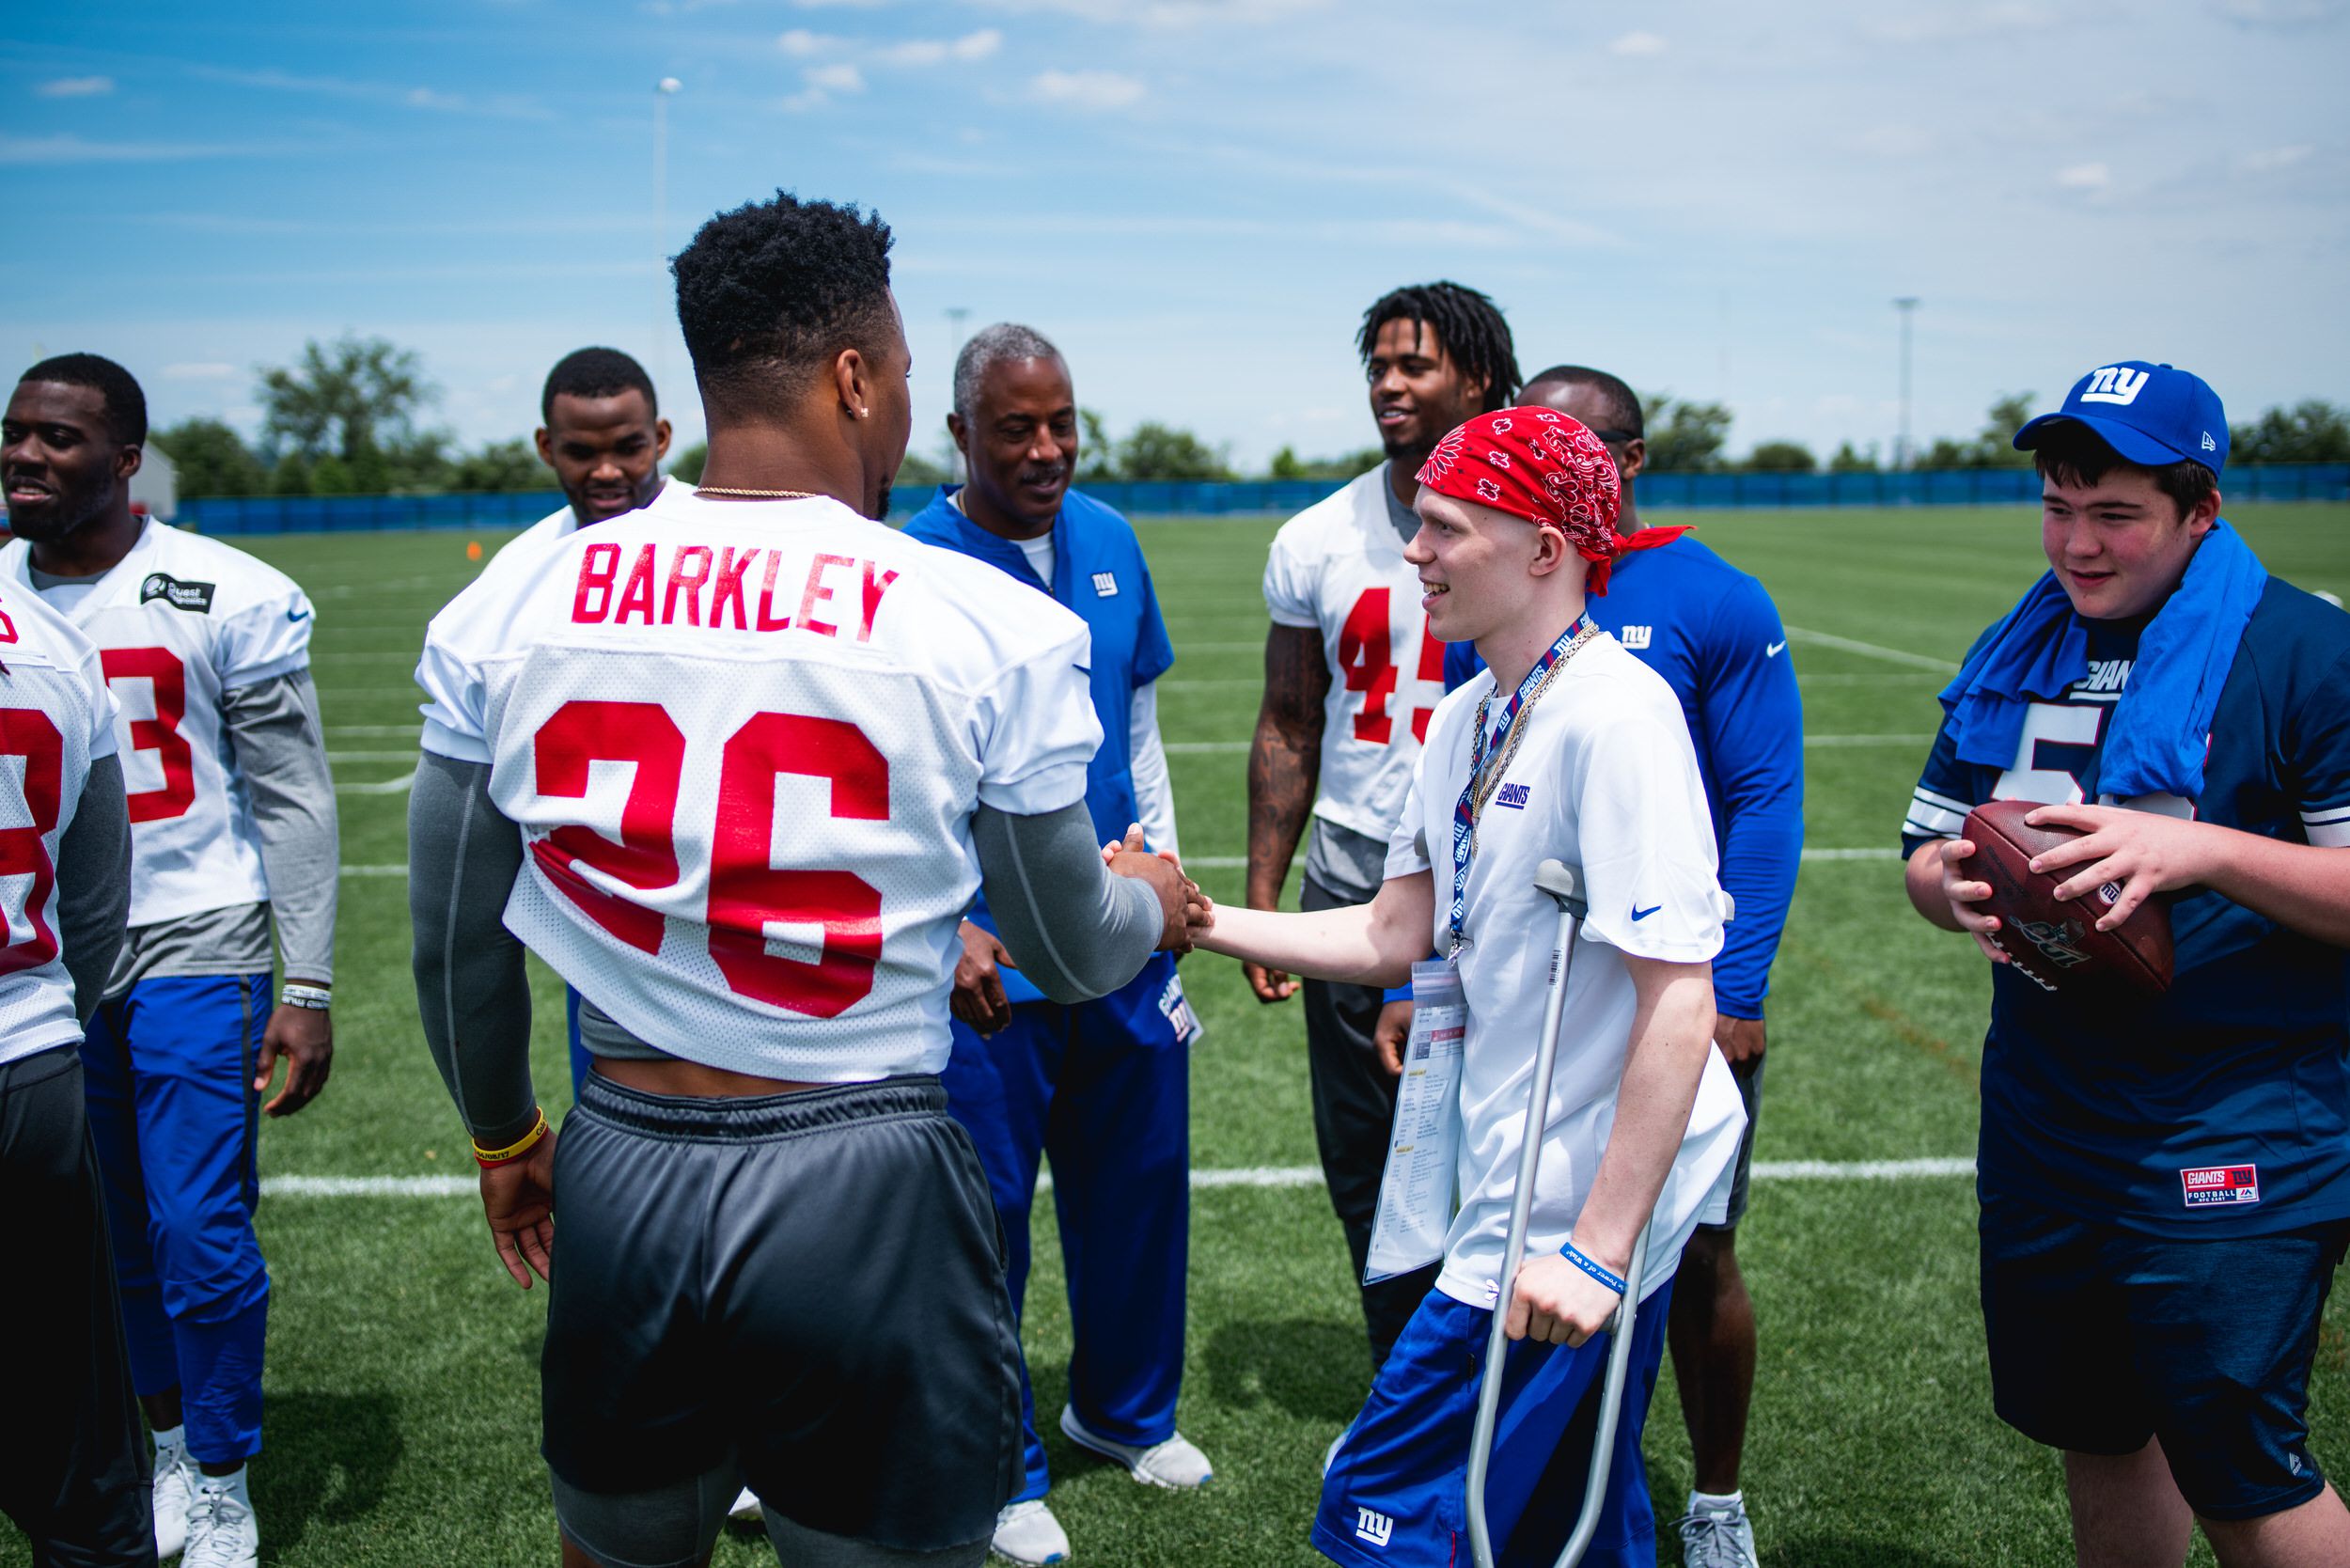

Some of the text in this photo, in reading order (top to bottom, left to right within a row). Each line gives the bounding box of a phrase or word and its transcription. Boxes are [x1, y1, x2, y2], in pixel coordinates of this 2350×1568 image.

[572, 542, 900, 642] BARKLEY
[1519, 665, 1546, 700] GIANTS
[1497, 783, 1531, 807] GIANTS
[528, 700, 889, 1019] 26
[2187, 1170, 2225, 1185] GIANTS
[2187, 1189, 2235, 1200] FOOTBALL
[1597, 1271, 1618, 1287] Power
